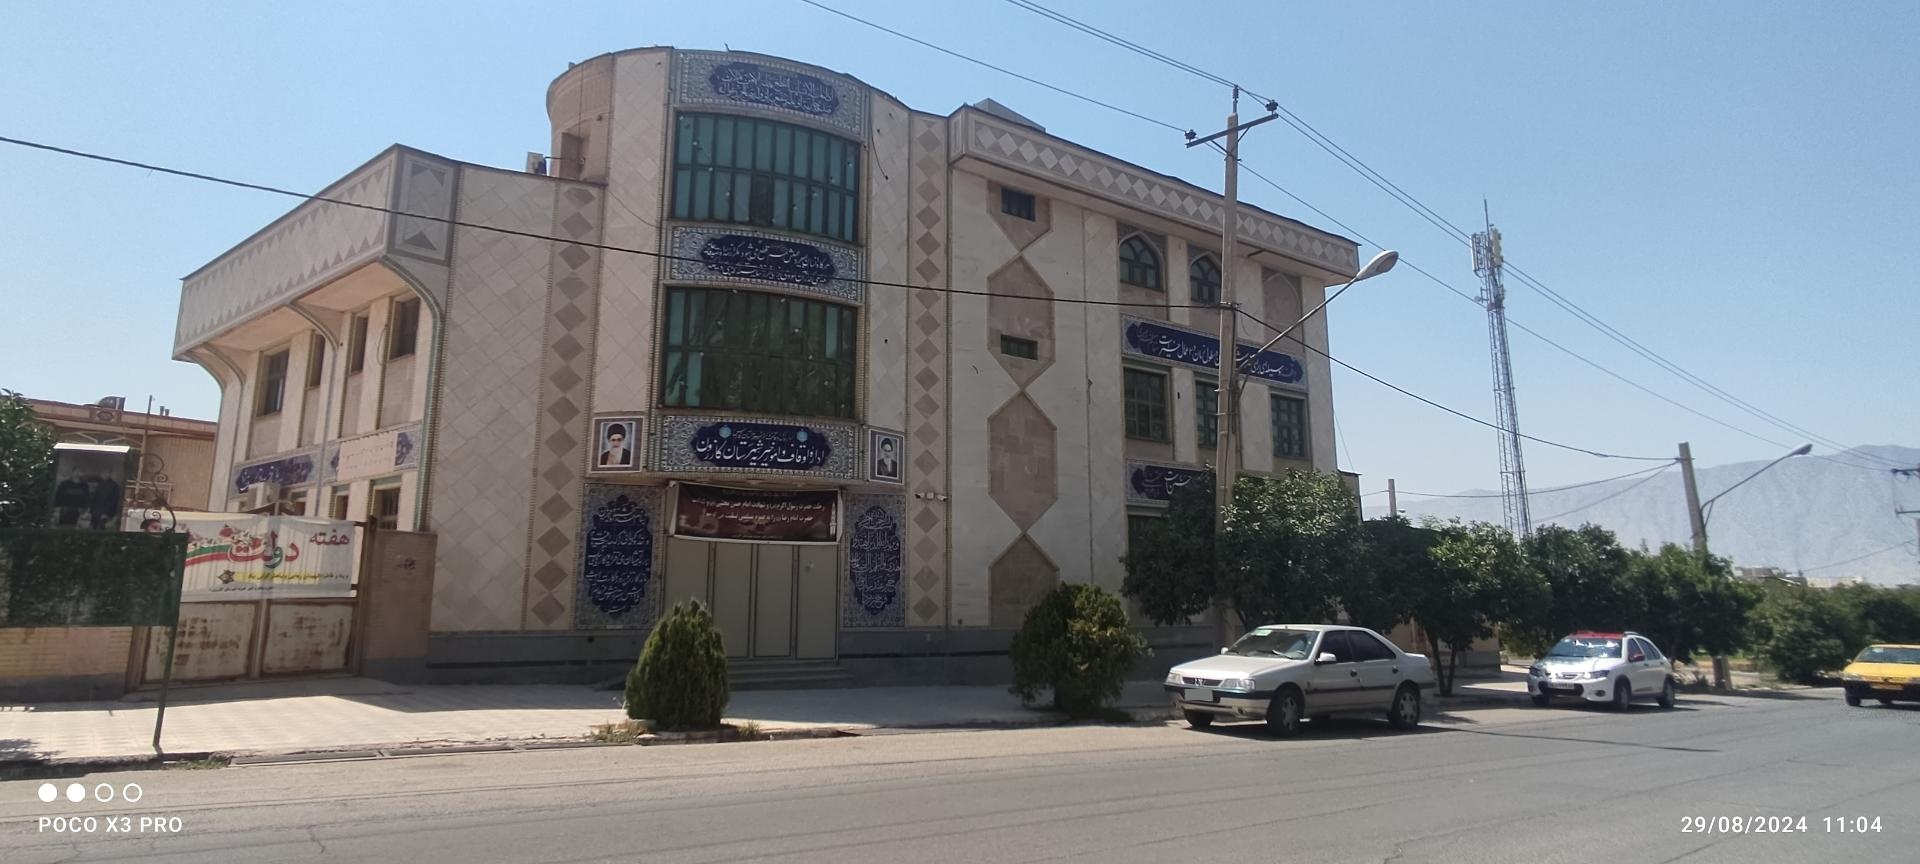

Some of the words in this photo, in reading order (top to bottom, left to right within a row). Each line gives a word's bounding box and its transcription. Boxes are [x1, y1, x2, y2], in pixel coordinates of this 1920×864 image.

[695, 437, 728, 461] کازرون
[722, 439, 765, 461] شهرستان
[749, 442, 776, 467] خیریه
[777, 443, 810, 463] اوقاف
[309, 528, 350, 546] هفته
[227, 530, 300, 569] دولت
